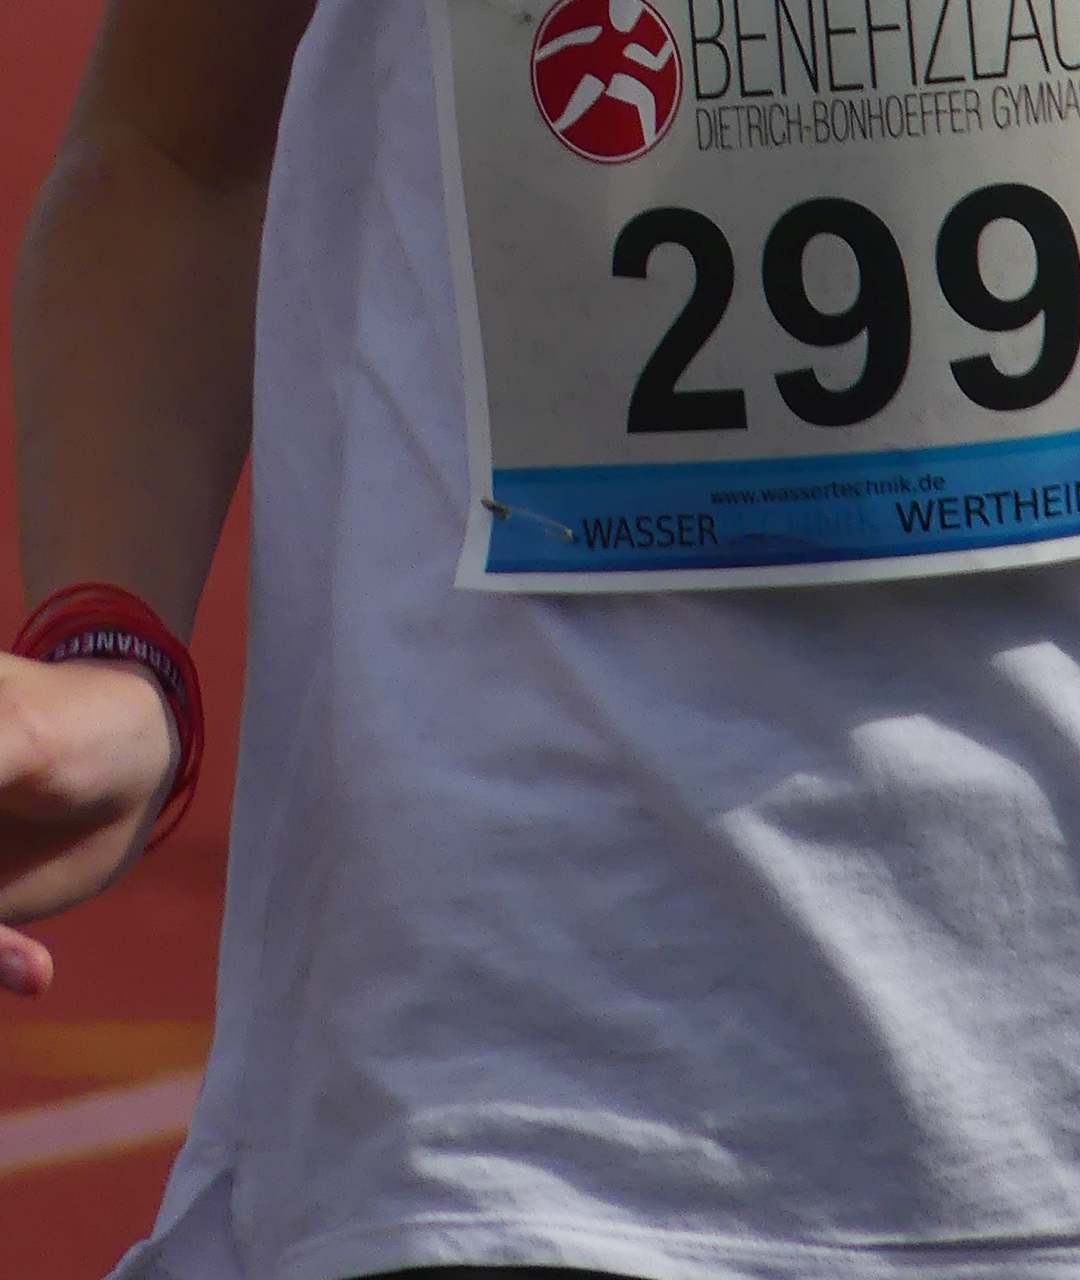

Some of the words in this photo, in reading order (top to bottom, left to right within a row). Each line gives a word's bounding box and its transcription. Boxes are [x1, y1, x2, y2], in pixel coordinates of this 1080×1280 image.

[695, 88, 984, 151] DIETRICH-BONHOEFFER
[710, 473, 945, 505] www.wassertechnik.de
[582, 513, 719, 550] WASSER
